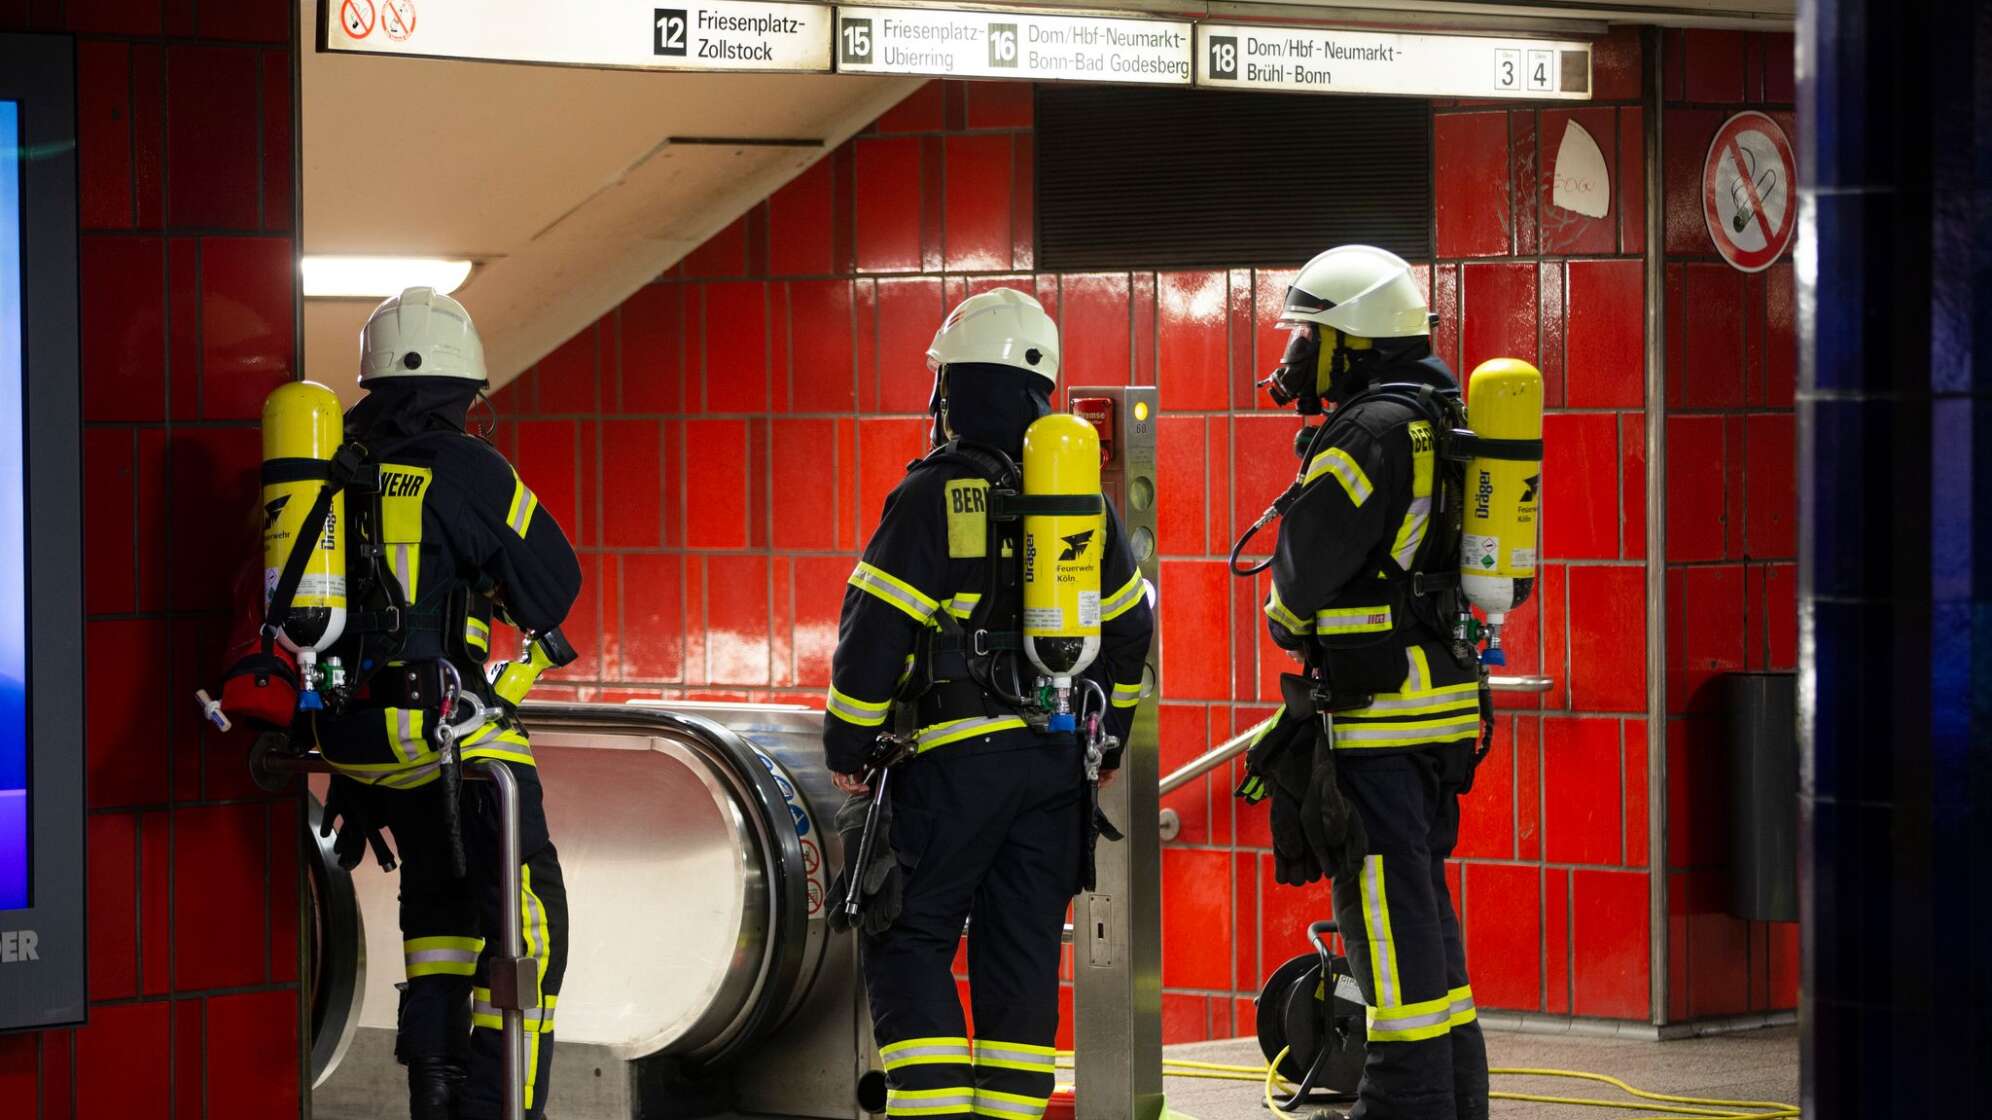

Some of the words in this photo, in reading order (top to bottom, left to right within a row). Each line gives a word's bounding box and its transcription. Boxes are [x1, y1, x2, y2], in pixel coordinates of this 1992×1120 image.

[657, 16, 685, 48] 12
[698, 10, 806, 36] Friesenplatz-
[884, 19, 985, 44] Friesenplatz-
[697, 38, 773, 61] Zollstock
[843, 25, 871, 57] 15
[990, 31, 1017, 62] 16
[884, 46, 954, 72] Ubierring
[1028, 51, 1104, 72] Bonn-Bad
[1110, 53, 1190, 79] Godesberg
[1211, 43, 1236, 73] 18
[1502, 61, 1514, 86] 3
[1533, 62, 1547, 87] 4
[1475, 469, 1493, 519] Dräger
